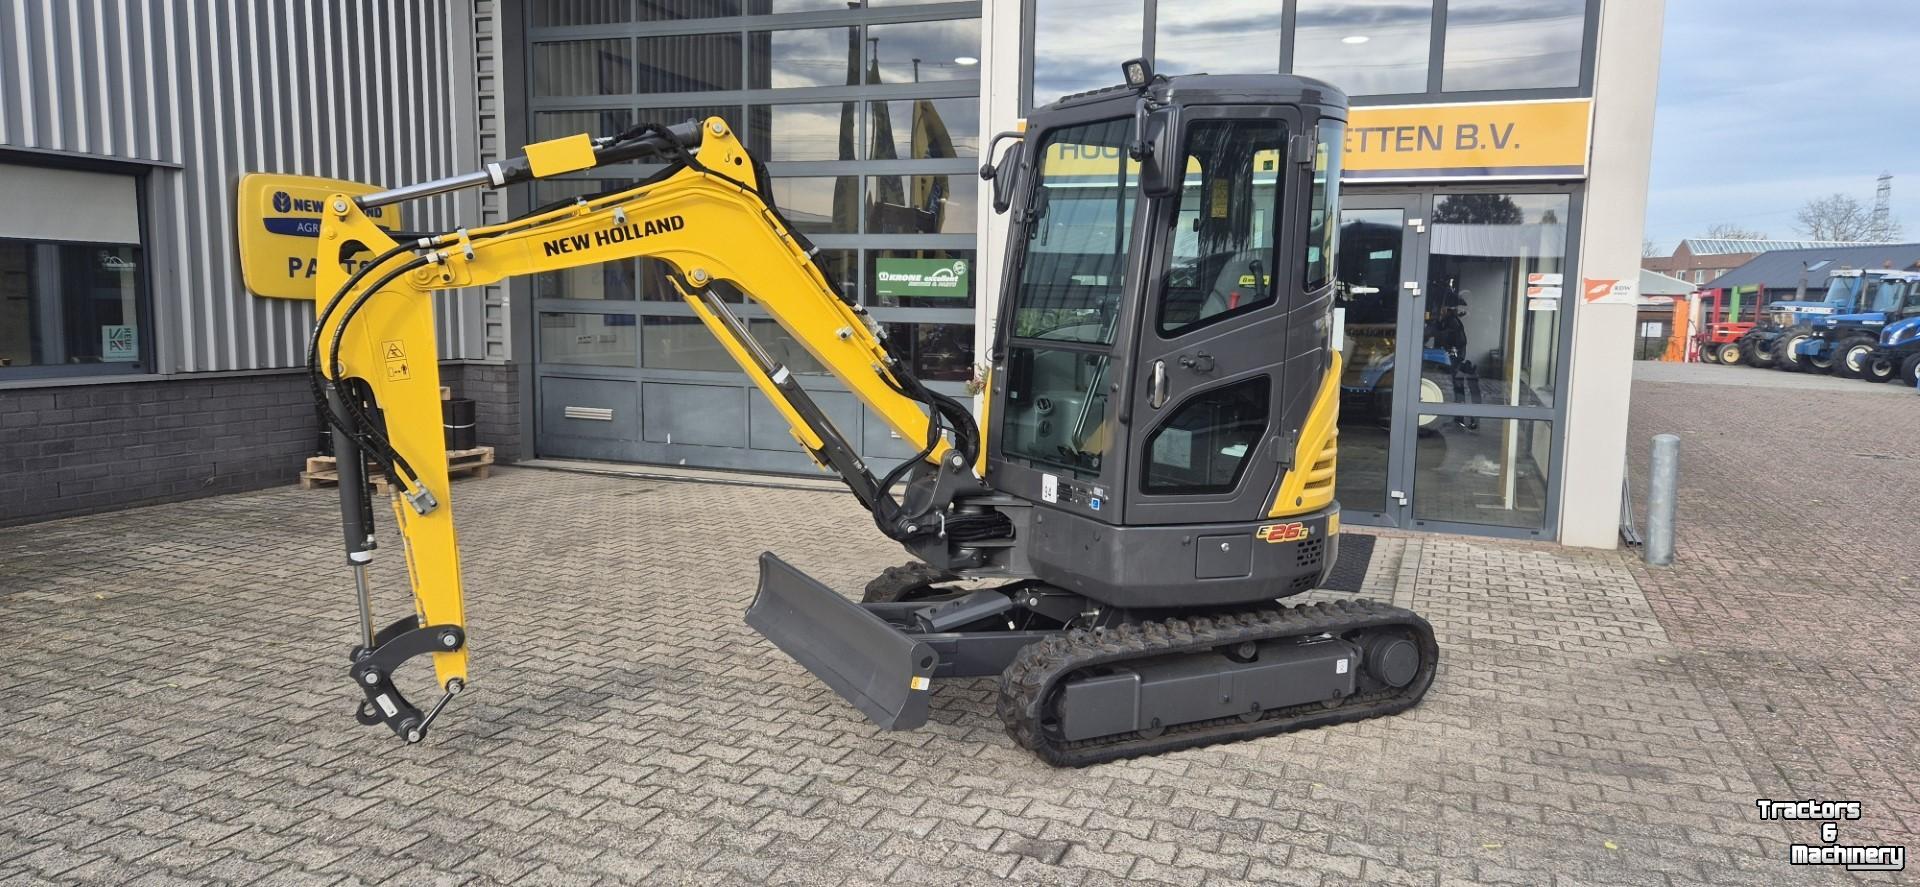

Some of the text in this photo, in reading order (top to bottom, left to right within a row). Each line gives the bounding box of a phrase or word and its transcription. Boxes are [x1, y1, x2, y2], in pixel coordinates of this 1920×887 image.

[1455, 122, 1520, 150] B.V.
[294, 198, 323, 213] NEW
[543, 215, 685, 257] NEW HOLLAND
